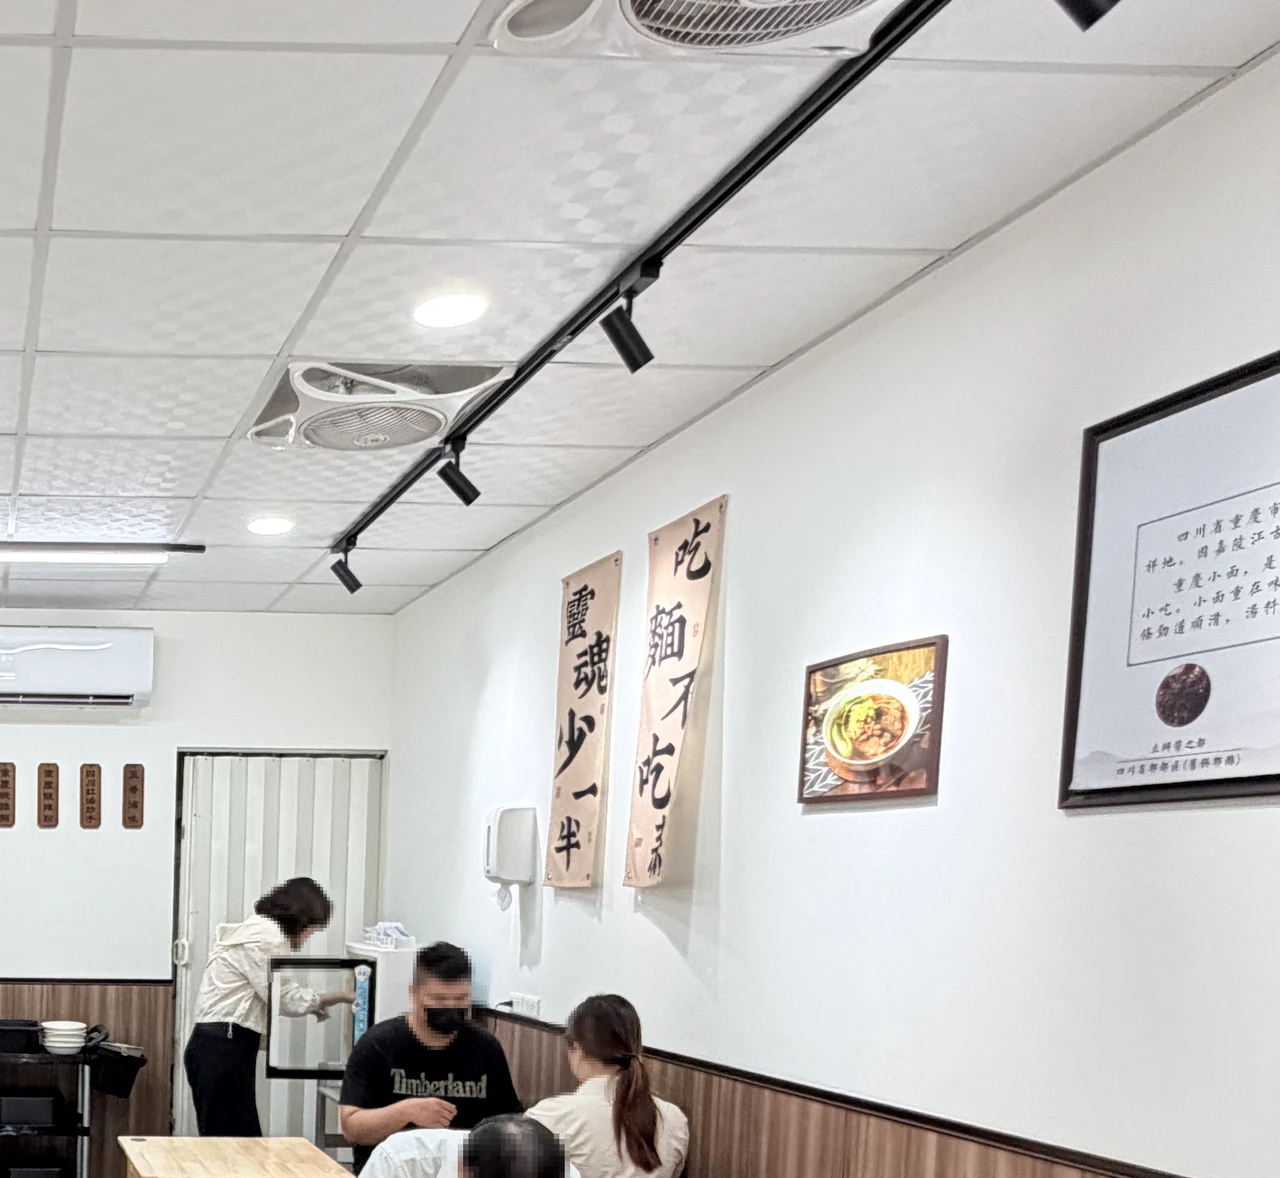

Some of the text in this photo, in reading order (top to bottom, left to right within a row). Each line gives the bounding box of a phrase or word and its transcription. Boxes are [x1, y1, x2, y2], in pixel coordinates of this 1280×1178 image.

[555, 583, 609, 873] 靈魂少一半
[390, 1068, 487, 1099] Timberland
